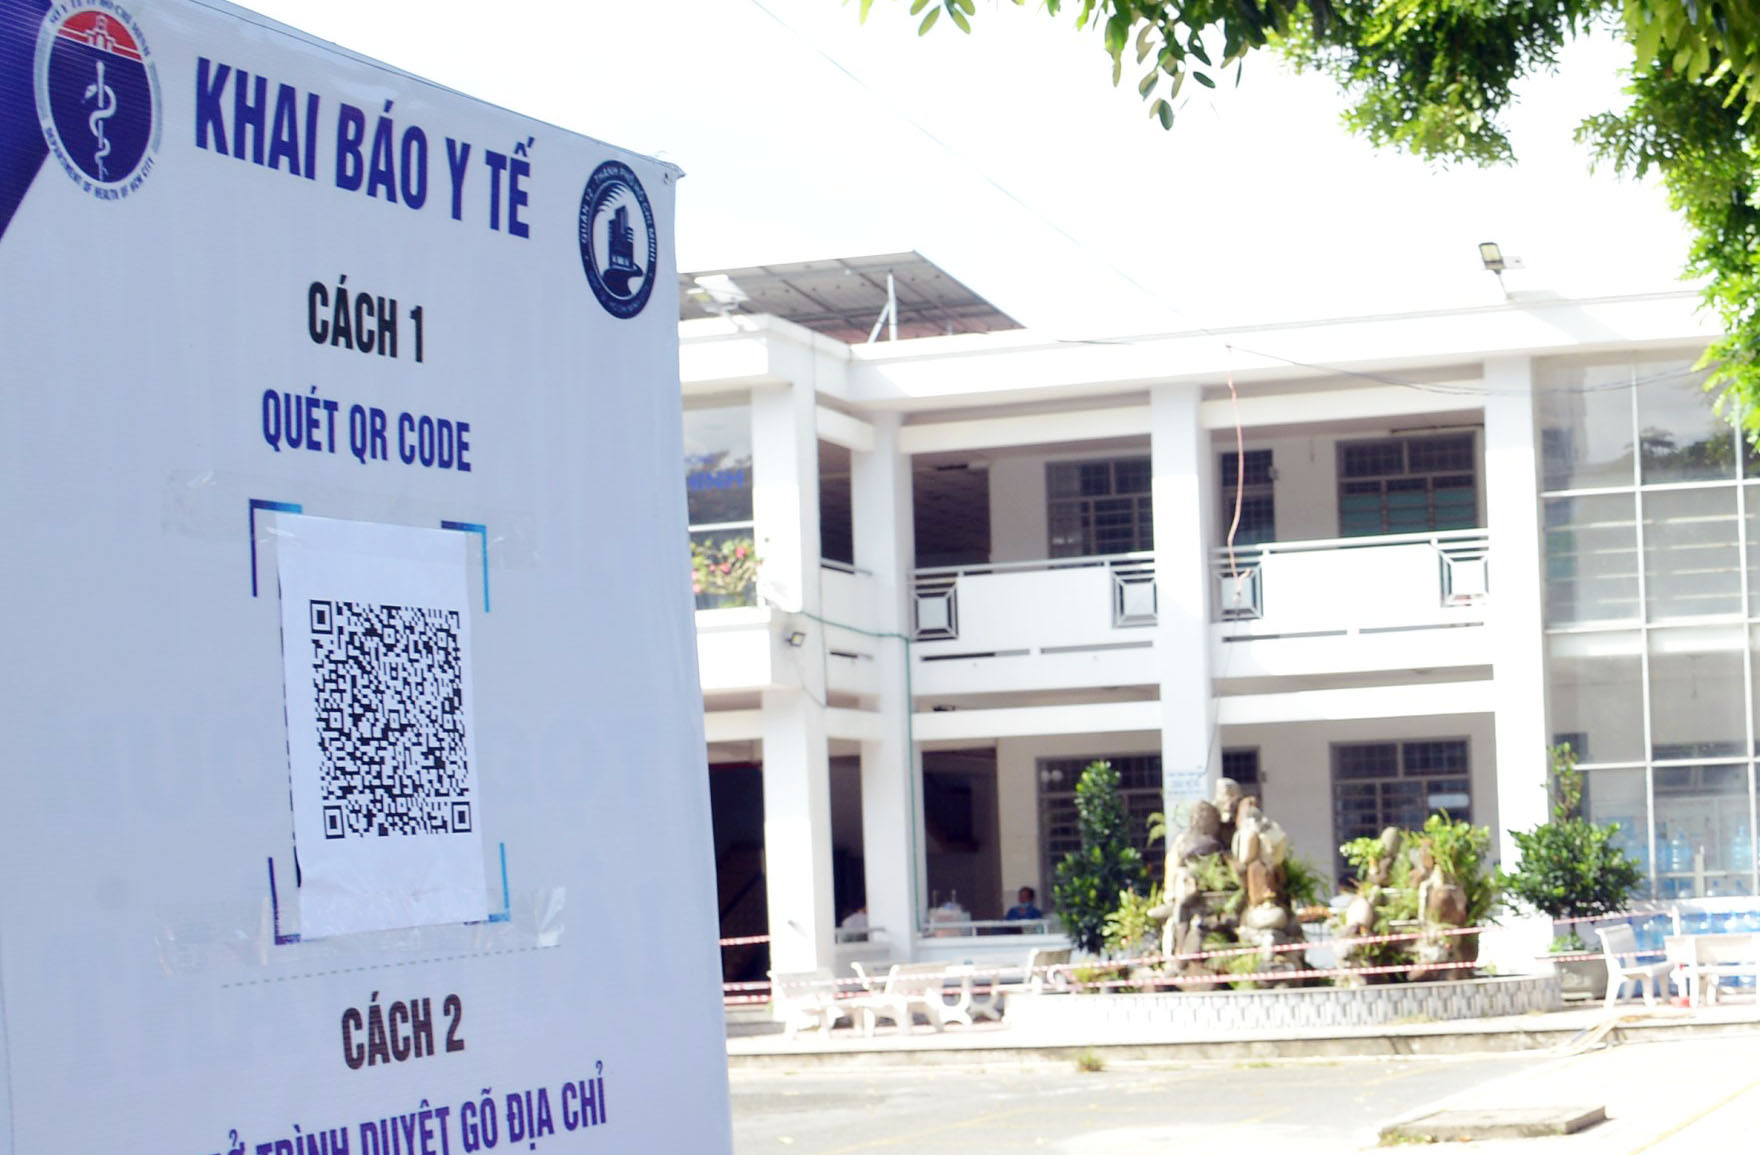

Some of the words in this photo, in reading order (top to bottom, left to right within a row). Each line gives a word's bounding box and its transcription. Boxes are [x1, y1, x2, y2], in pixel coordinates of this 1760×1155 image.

[195, 56, 321, 192] KHAI
[335, 99, 429, 210] BÁO
[445, 137, 472, 221] Y
[485, 136, 536, 239] TẾ
[308, 274, 398, 359] CÁCH
[409, 305, 423, 363] 1
[262, 385, 339, 454] QUÉT
[349, 404, 388, 466] QR
[398, 411, 472, 474] CODE
[341, 989, 435, 1070] CÁCH
[443, 993, 465, 1053] 2
[461, 1087, 498, 1154] GÕ
[505, 1088, 555, 1151] ĐỊA
[562, 1060, 607, 1132] CHỈ
